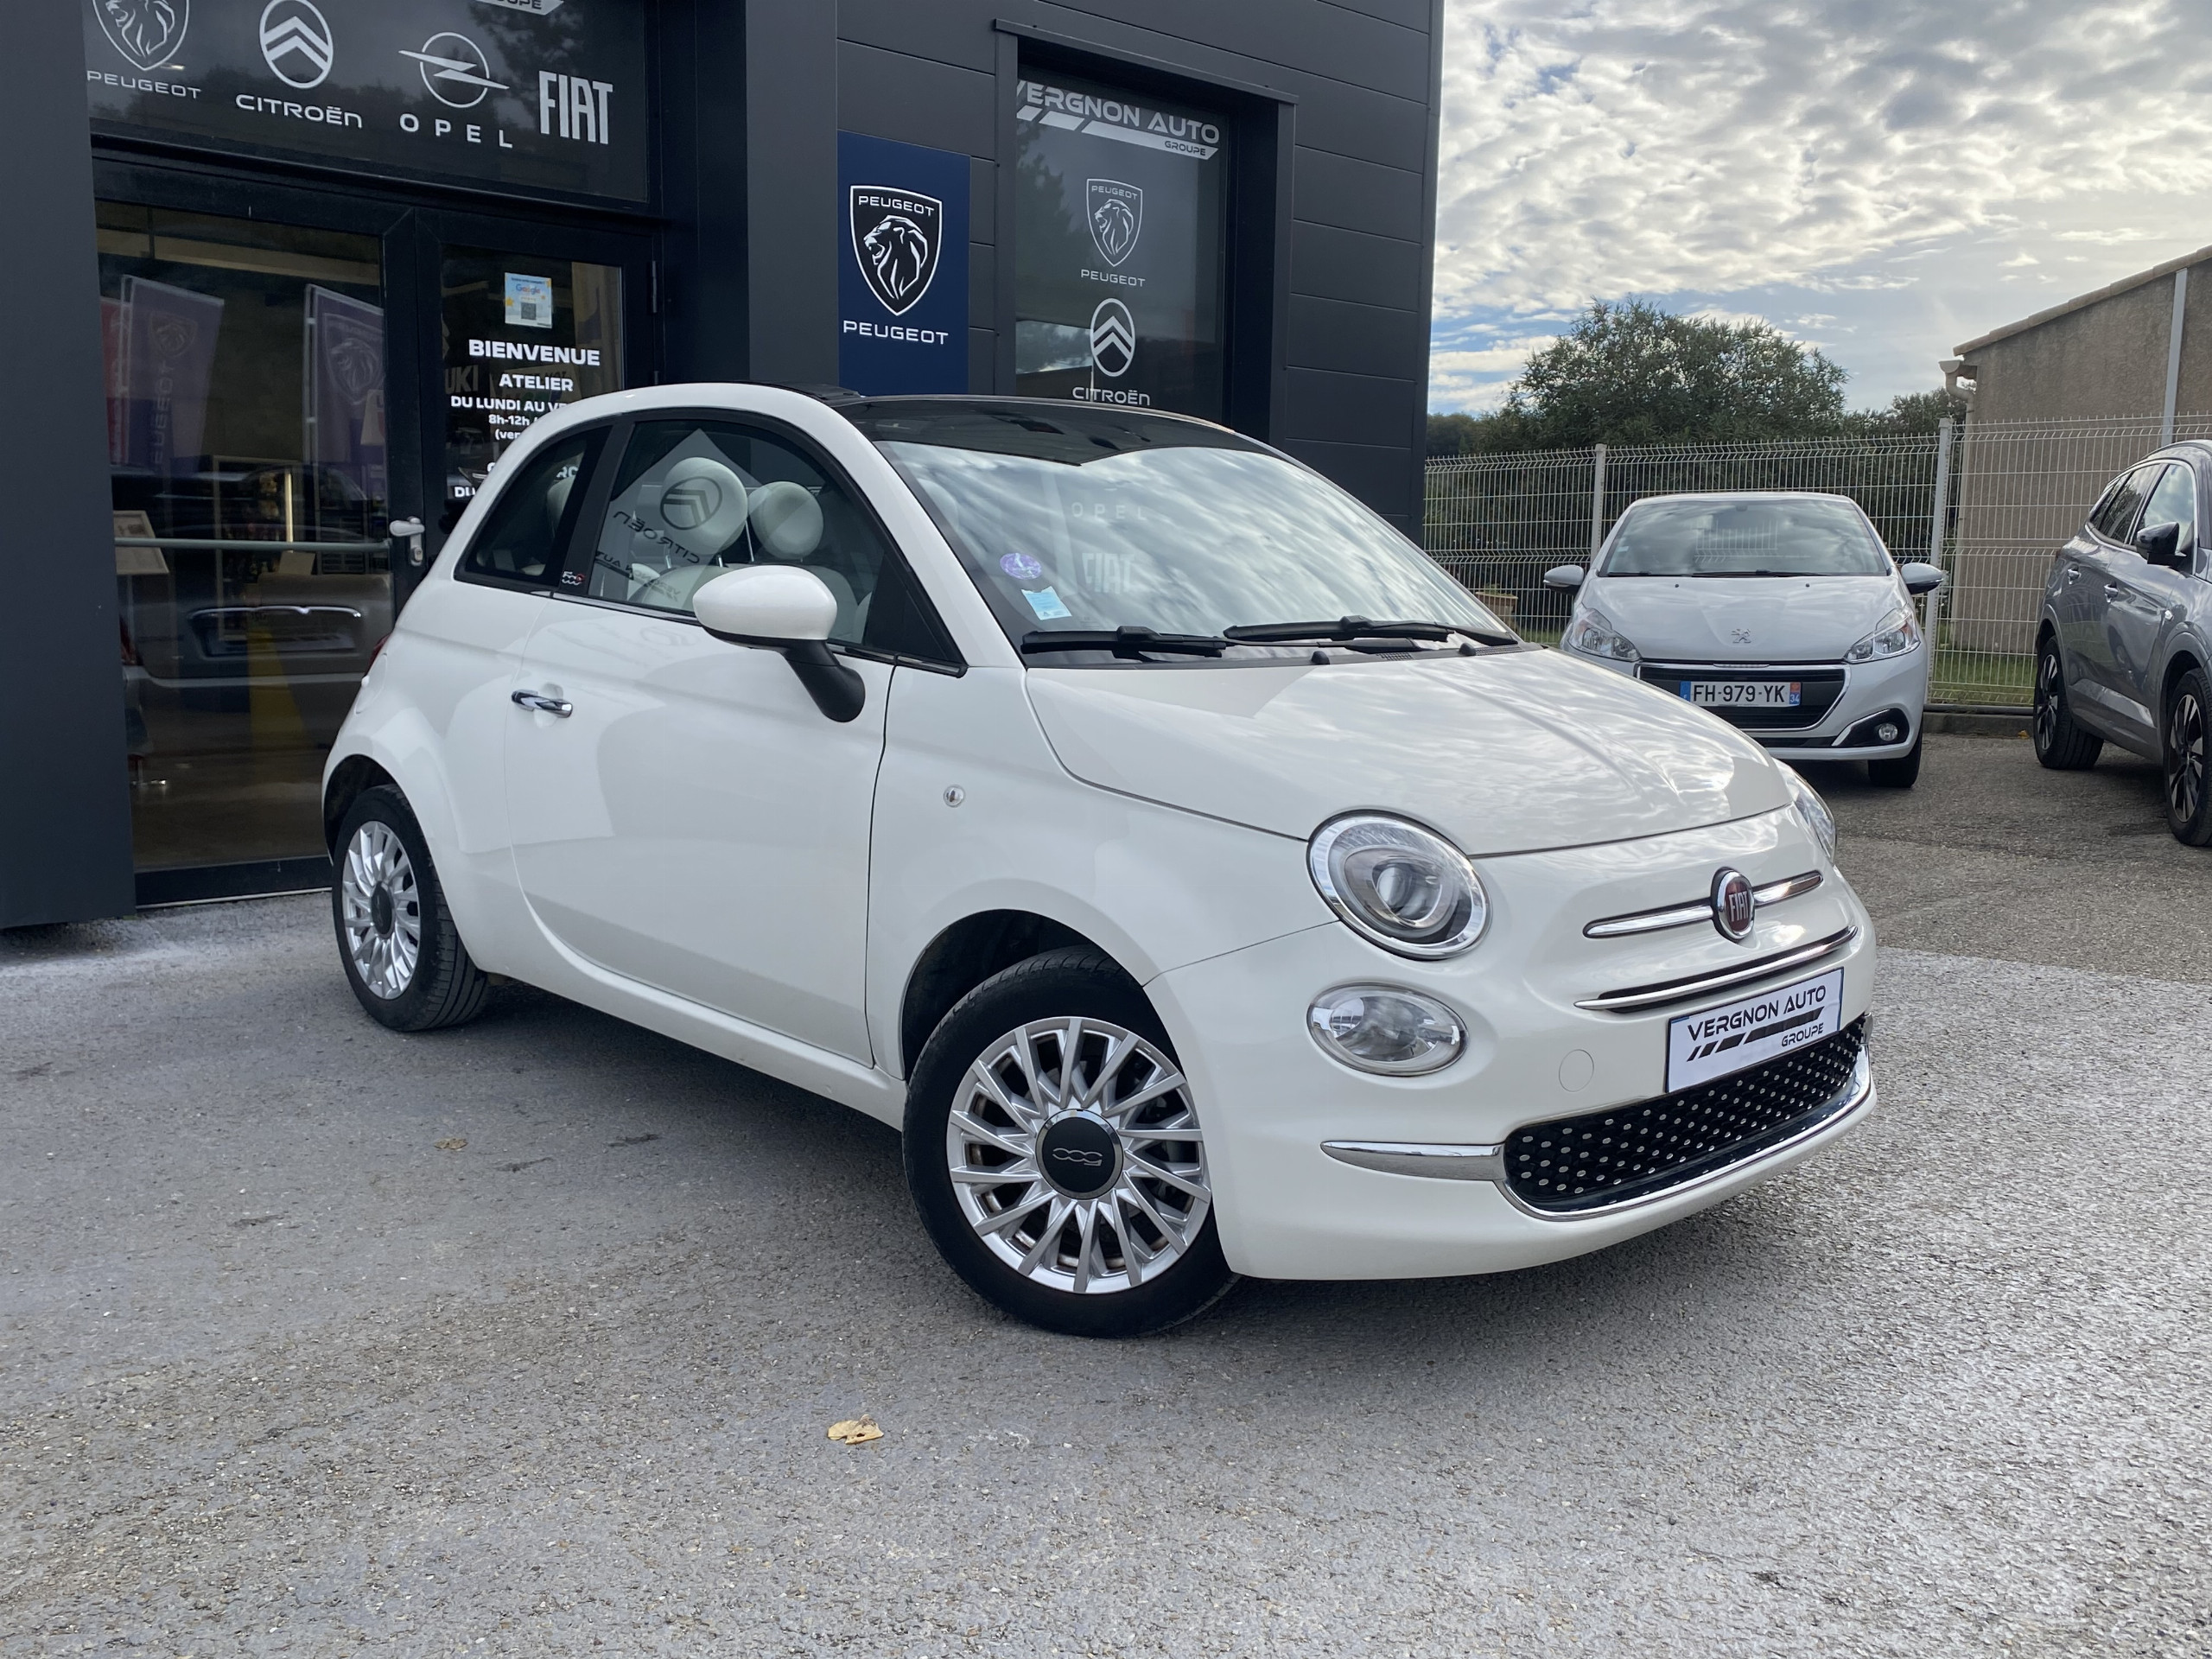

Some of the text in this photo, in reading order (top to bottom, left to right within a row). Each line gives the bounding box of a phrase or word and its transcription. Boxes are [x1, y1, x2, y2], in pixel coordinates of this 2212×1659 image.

[86, 70, 201, 99] PEUGEOT
[235, 93, 363, 129] CITROËN
[538, 70, 613, 145] FIAT
[399, 113, 513, 149] OPEL
[1147, 112, 1219, 144] AUTO
[1164, 140, 1206, 156] GROUPE
[1091, 185, 1138, 200] PEUGEOT
[858, 195, 934, 216] PEUGEOT
[1081, 269, 1146, 288] PEUGEOT
[843, 321, 949, 345] PEUGEOT
[468, 339, 601, 366] BIENVENUE
[499, 373, 574, 392] ATELIER
[451, 396, 473, 409] DU
[476, 397, 520, 411] LUNDI
[524, 400, 545, 412] AU
[1072, 387, 1150, 406] CITROËN
[488, 414, 530, 426] 8h-12h
[1693, 684, 1785, 702] FH-979-YK
[1789, 693, 1801, 703] 34
[1728, 891, 1748, 922] FIAT
[1687, 984, 1827, 1041] VERGNON AUTO
[1781, 1021, 1824, 1047] GROUPE
